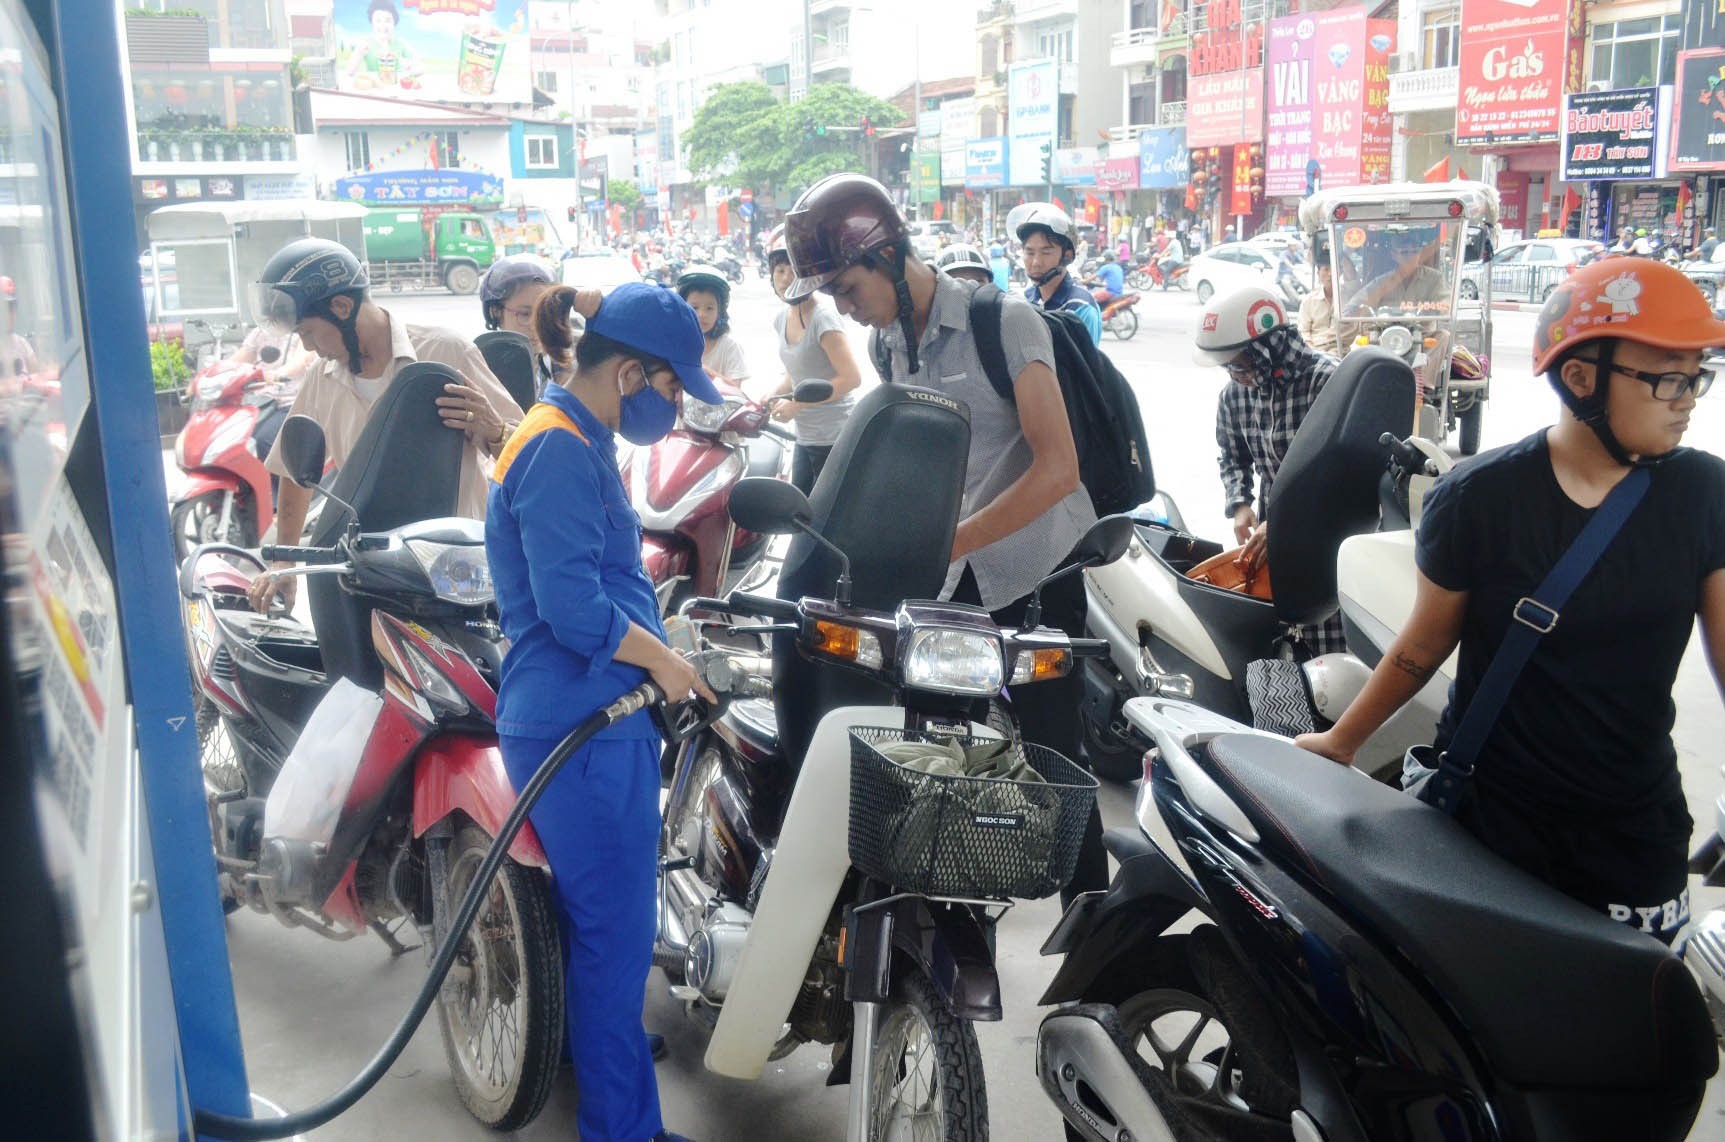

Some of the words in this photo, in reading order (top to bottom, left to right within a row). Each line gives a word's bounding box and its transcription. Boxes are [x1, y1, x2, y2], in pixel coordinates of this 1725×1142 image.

[1482, 45, 1543, 81] Gas
[1317, 75, 1359, 105] VÀNG
[1323, 110, 1352, 136] BẠC
[1571, 143, 1603, 161] 18
[905, 391, 961, 412] HONDA
[998, 817, 1016, 825] SON
